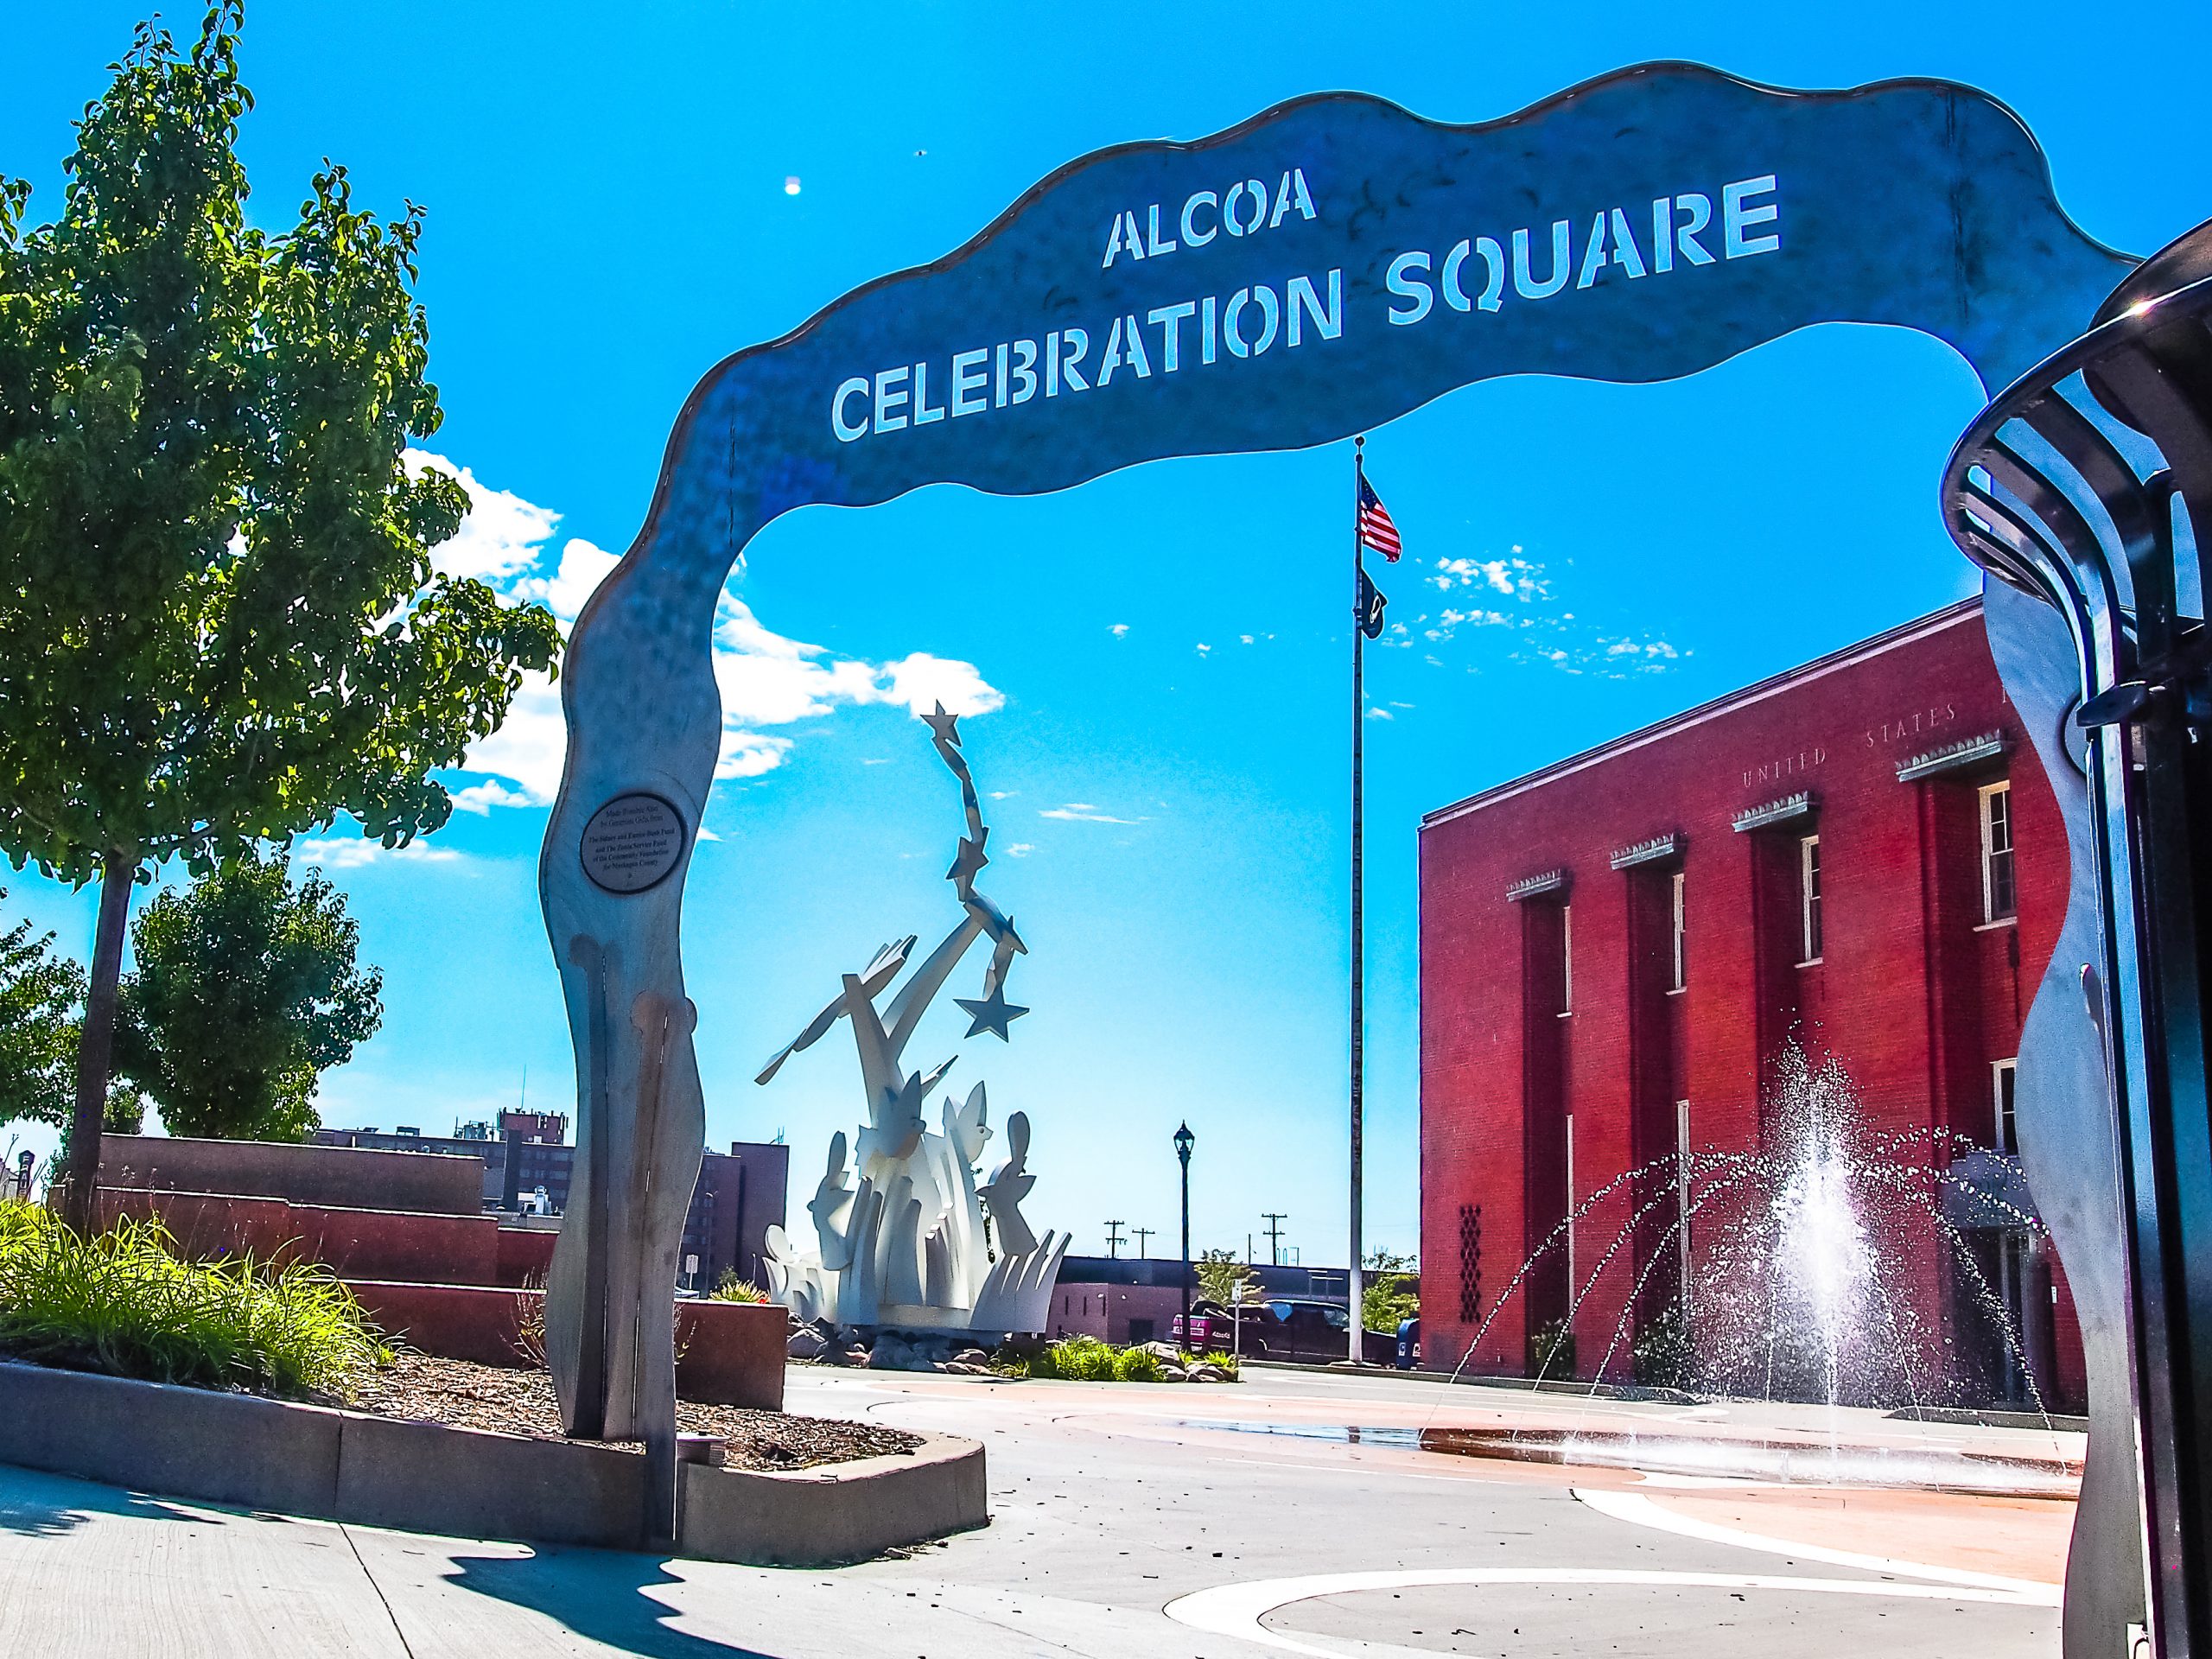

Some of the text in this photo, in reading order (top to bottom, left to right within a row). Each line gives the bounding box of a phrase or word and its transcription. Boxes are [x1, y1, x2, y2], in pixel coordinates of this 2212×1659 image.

[1102, 168, 1317, 270] ALCOA
[831, 174, 1780, 443] CELEBRATION SQUARE
[1742, 702, 1957, 789] UNITED STATES
